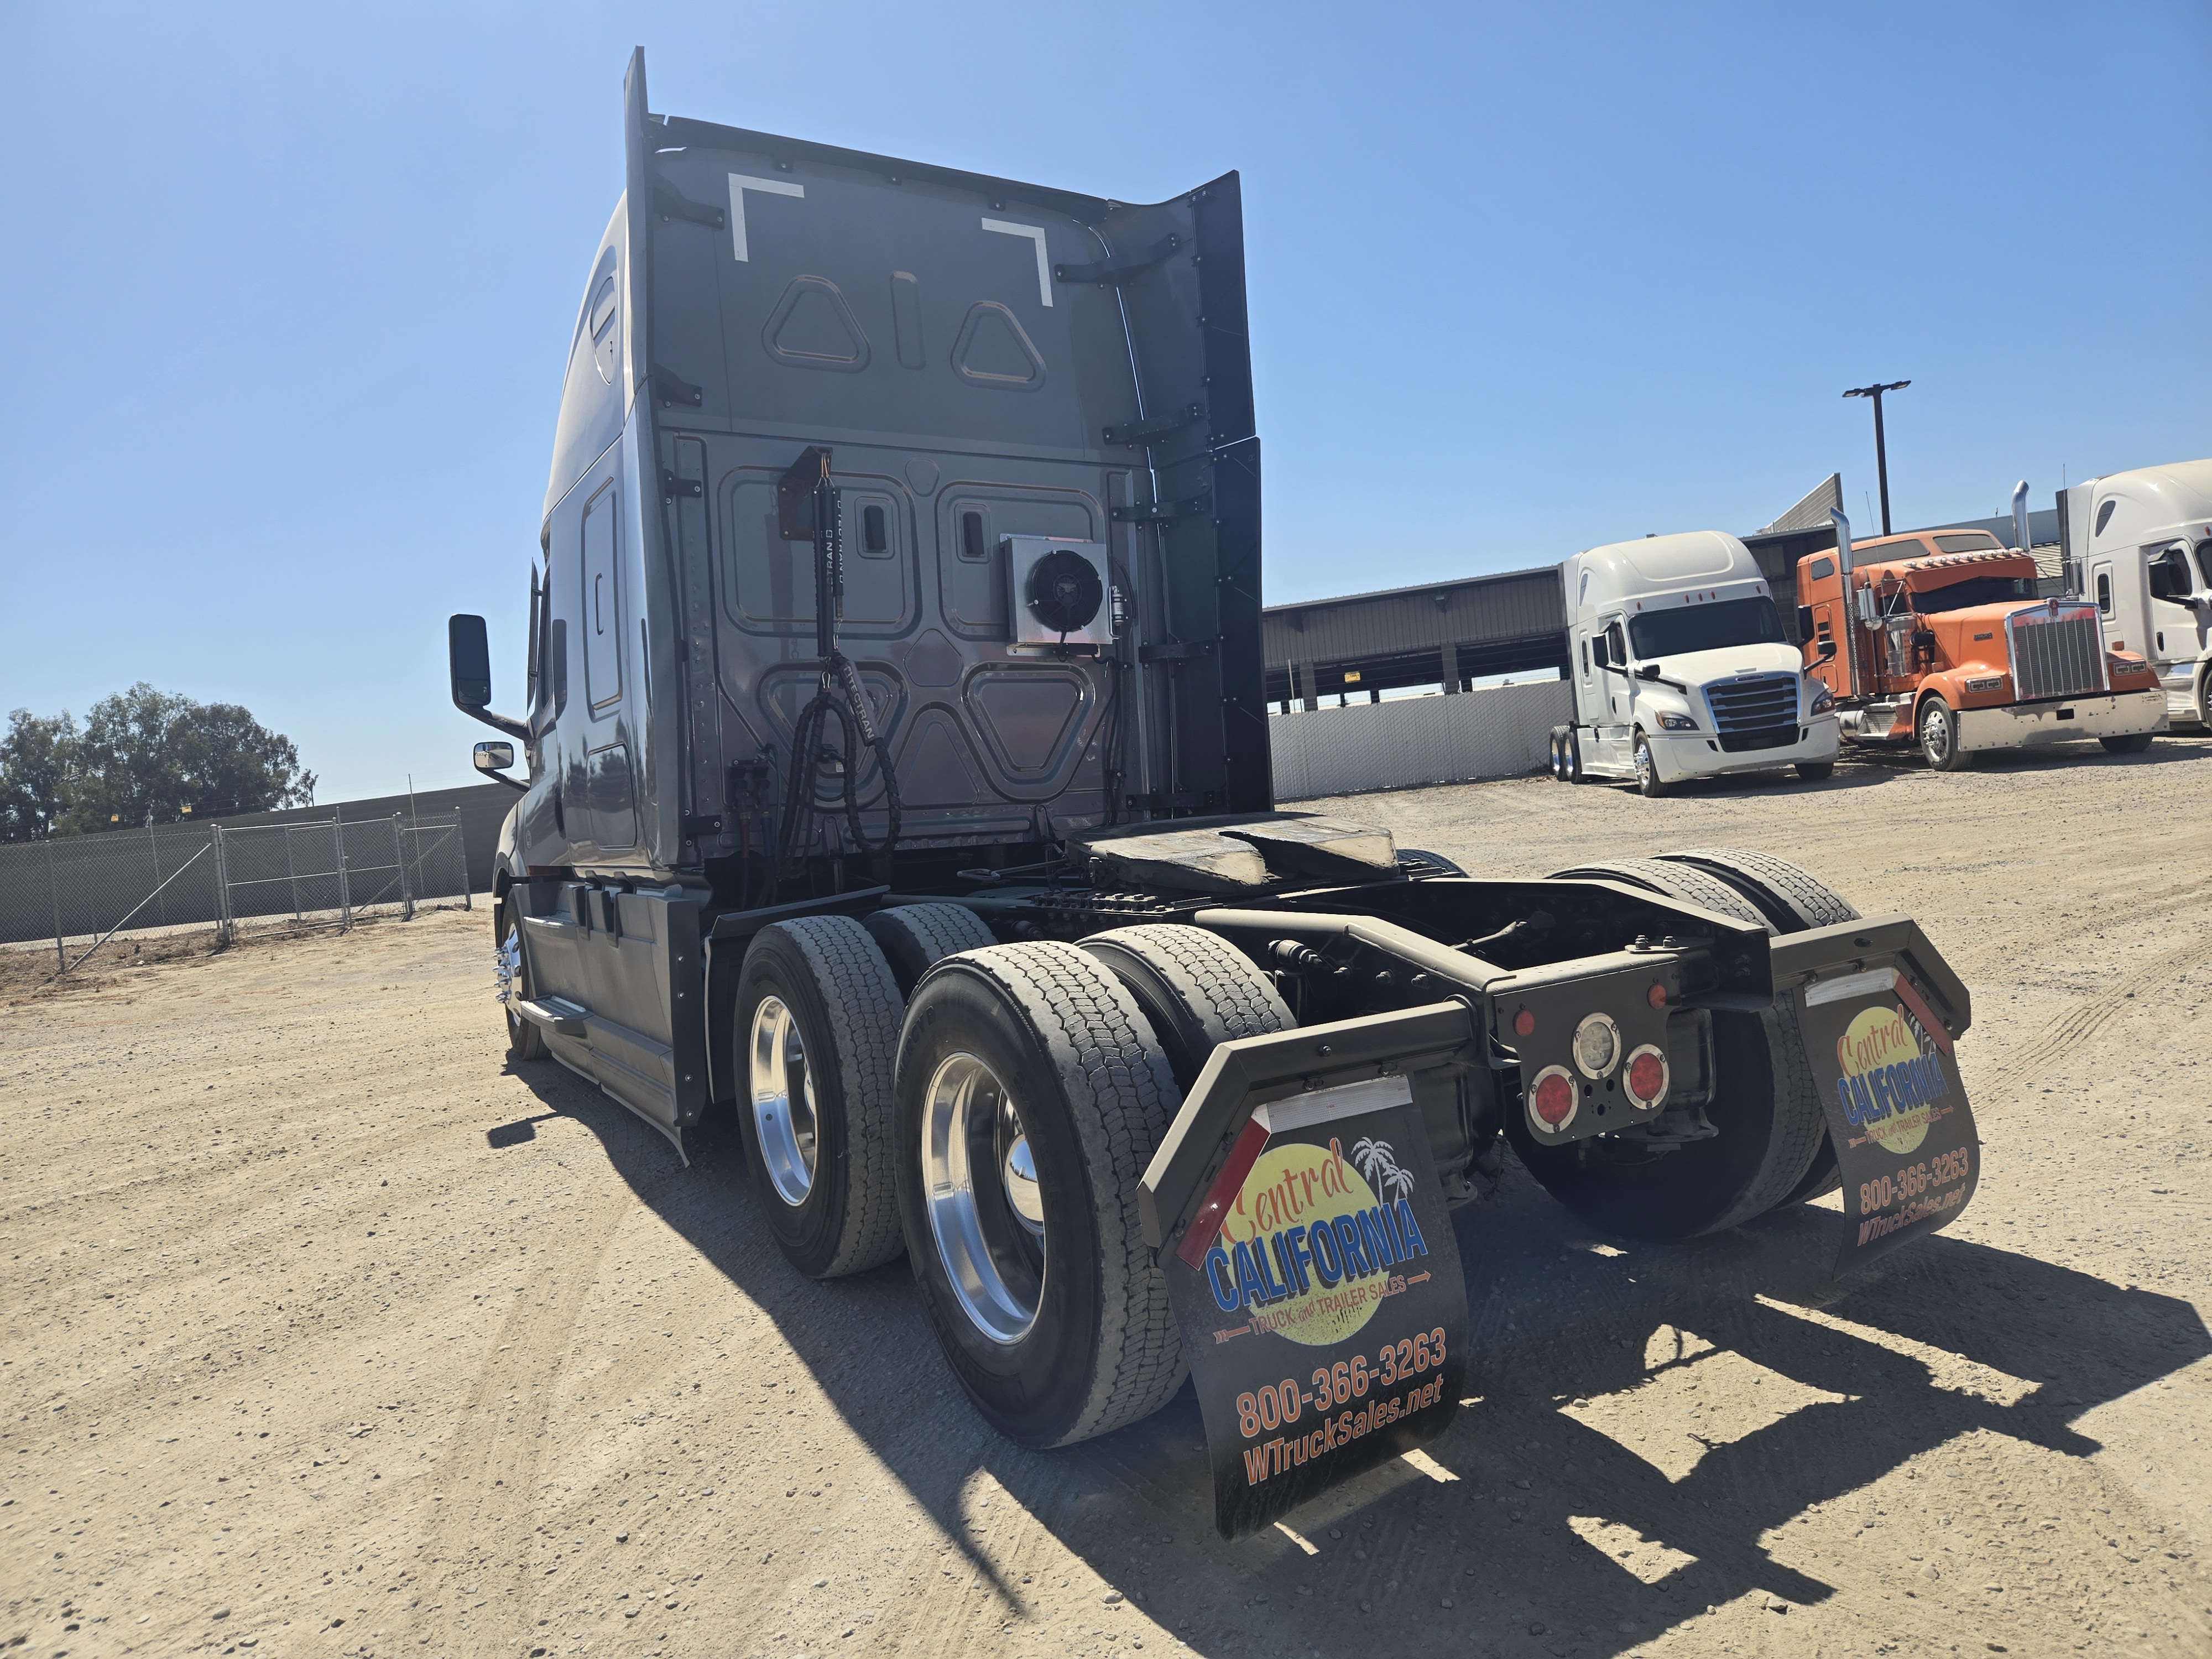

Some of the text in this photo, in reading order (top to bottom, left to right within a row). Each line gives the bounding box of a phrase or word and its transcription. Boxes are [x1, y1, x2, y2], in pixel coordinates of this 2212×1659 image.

[848, 676, 875, 739] TECTRAN
[1837, 1004, 1908, 1079] Central
[1838, 1052, 1950, 1126] CALIFORNIA
[1865, 1125, 1888, 1144] TRUCK
[1897, 1114, 1921, 1133] TRAILER
[1922, 1107, 1942, 1124] SALES
[1220, 1137, 1354, 1245] Central
[1858, 1182, 1966, 1247] WTruckSales.net
[1860, 1147, 1969, 1215] 800-366-3263
[1206, 1198, 1428, 1312] CALIFORNIA
[1249, 1275, 1407, 1335] TRUCK and TRAILER SALES
[1237, 1327, 1446, 1438] 800-366-3263
[1244, 1374, 1444, 1486] WTruckSales.net
